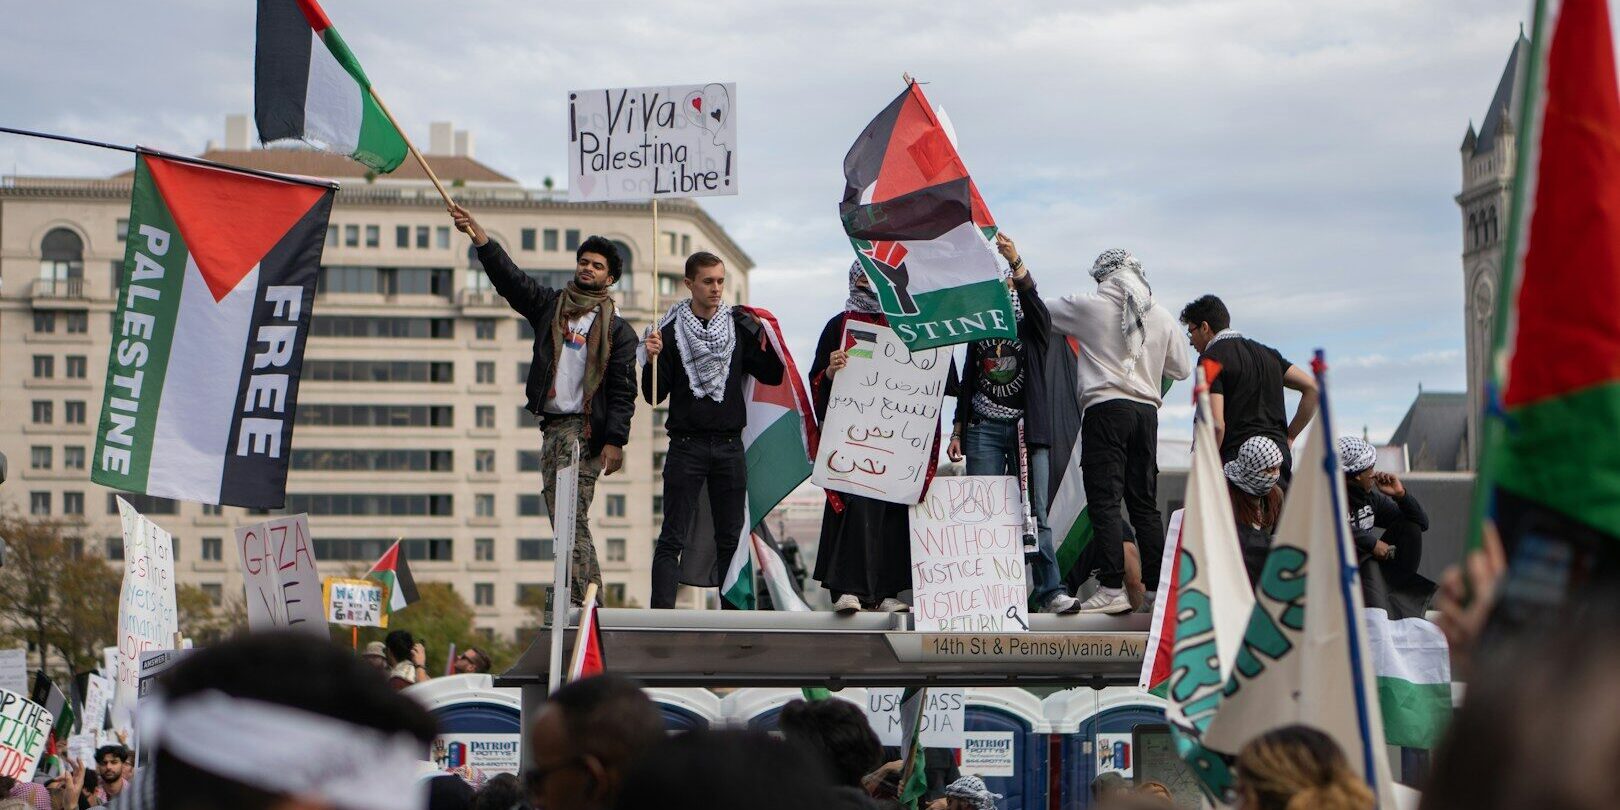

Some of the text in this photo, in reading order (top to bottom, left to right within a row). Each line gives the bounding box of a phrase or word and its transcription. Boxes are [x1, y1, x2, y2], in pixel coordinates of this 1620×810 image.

[580, 131, 687, 176] Palestina
[102, 223, 171, 476] PALESTINE
[236, 285, 304, 458] FREE
[914, 494, 944, 521] NO
[244, 521, 313, 575] GAZA
[914, 524, 1022, 557] WITHOUT
[912, 556, 1022, 590] JUSTICE NO
[259, 581, 306, 626] WE
[915, 588, 982, 622] JUSTICE
[938, 614, 1004, 632] RETURN
[933, 637, 964, 655] 14th
[970, 637, 987, 655] St
[993, 638, 1003, 655] &
[1009, 638, 1112, 660] Pennsylvania
[18, 697, 47, 732] THE
[871, 693, 962, 712] USA ASS
[889, 714, 954, 733] MDIA
[470, 741, 518, 752] PATRIOT
[966, 739, 1012, 749] PATRIOT
